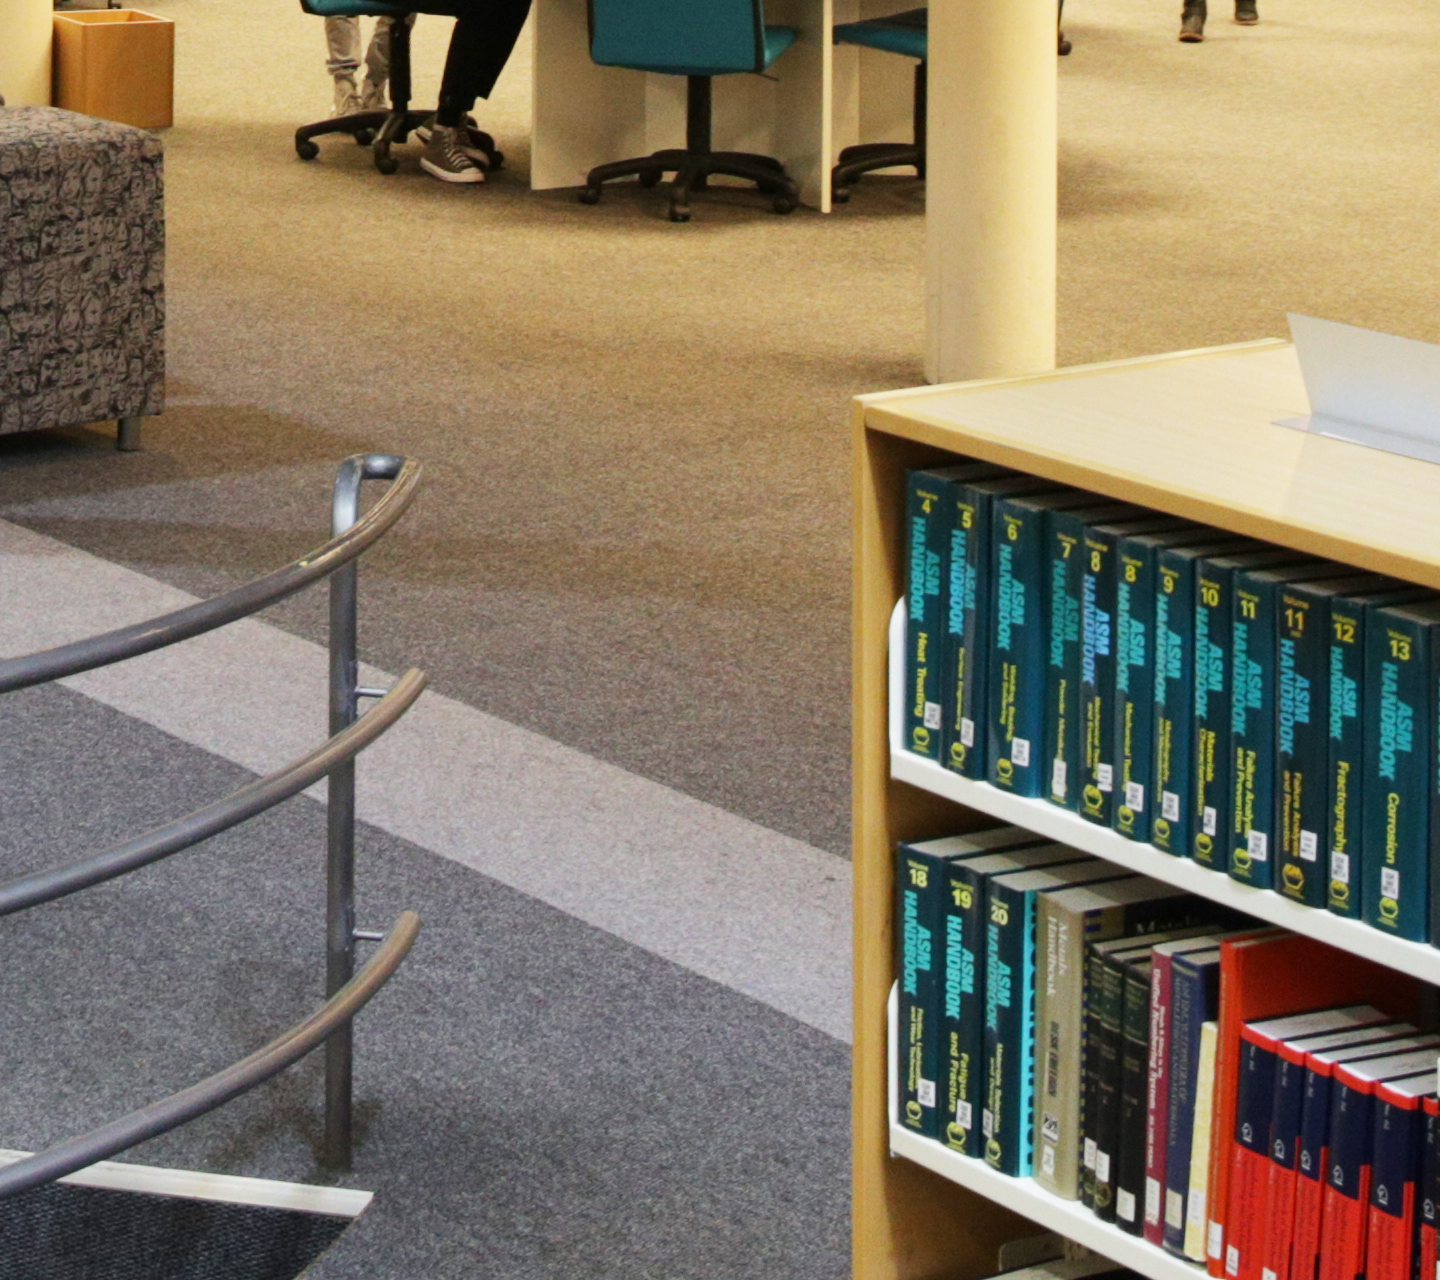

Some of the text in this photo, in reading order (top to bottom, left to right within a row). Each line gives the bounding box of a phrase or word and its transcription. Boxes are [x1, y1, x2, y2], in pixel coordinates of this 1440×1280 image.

[922, 500, 931, 513] 4
[962, 511, 972, 528] 5
[1007, 524, 1018, 540] 6
[1062, 542, 1071, 558] 7
[910, 516, 926, 622] HANDBOOK
[925, 549, 940, 595] ASM
[949, 529, 966, 636] HANDBOOK
[1090, 551, 1101, 572] 8
[1125, 565, 1136, 582] 8
[1164, 576, 1173, 594] 9
[964, 564, 976, 610] ASM
[997, 543, 1012, 650] HANDBOOK
[1010, 578, 1025, 625] ASM
[1201, 587, 1219, 606] 10
[1240, 600, 1256, 619] 11
[1050, 559, 1066, 668] HANDBOOK
[1064, 596, 1079, 642] ASM
[1082, 574, 1096, 687] HANDBOOK
[1094, 607, 1110, 656] ASM
[1285, 609, 1305, 630] 11
[1334, 623, 1354, 643] 12
[1117, 582, 1130, 694] HANDBOOK
[1129, 618, 1145, 666] ASM
[1155, 593, 1168, 706] HANDBOOK
[1166, 630, 1182, 679] ASM
[1390, 640, 1411, 660] 13
[1195, 606, 1208, 719] HANDBOOK
[1207, 642, 1223, 692] ASM
[1232, 622, 1248, 737] HANDBOOK
[1247, 659, 1262, 709] ASM
[1279, 639, 1294, 757] HANDBOOK
[1294, 674, 1310, 724] ASM
[1329, 645, 1343, 742] HANDBOOK
[1342, 676, 1357, 718] ASM
[1379, 661, 1398, 782] HANDBOOK
[1396, 700, 1413, 752] ASM
[1333, 760, 1350, 853] Fractography
[1385, 792, 1400, 865] Corrosion
[910, 869, 927, 888] 18
[952, 889, 972, 909] 19
[991, 905, 1009, 926] 20
[904, 890, 917, 996] HANDBOOK
[916, 924, 931, 971] ASM
[1047, 916, 1058, 996] Handbook
[945, 915, 962, 1020] HANDBOOK
[961, 948, 974, 994] ASM
[987, 924, 999, 1032] HANDBOOK
[997, 961, 1011, 1007] ASM
[948, 1031, 959, 1113] and Fracture
[958, 1052, 970, 1100] Fatigue
[1149, 1070, 1159, 1110] System
